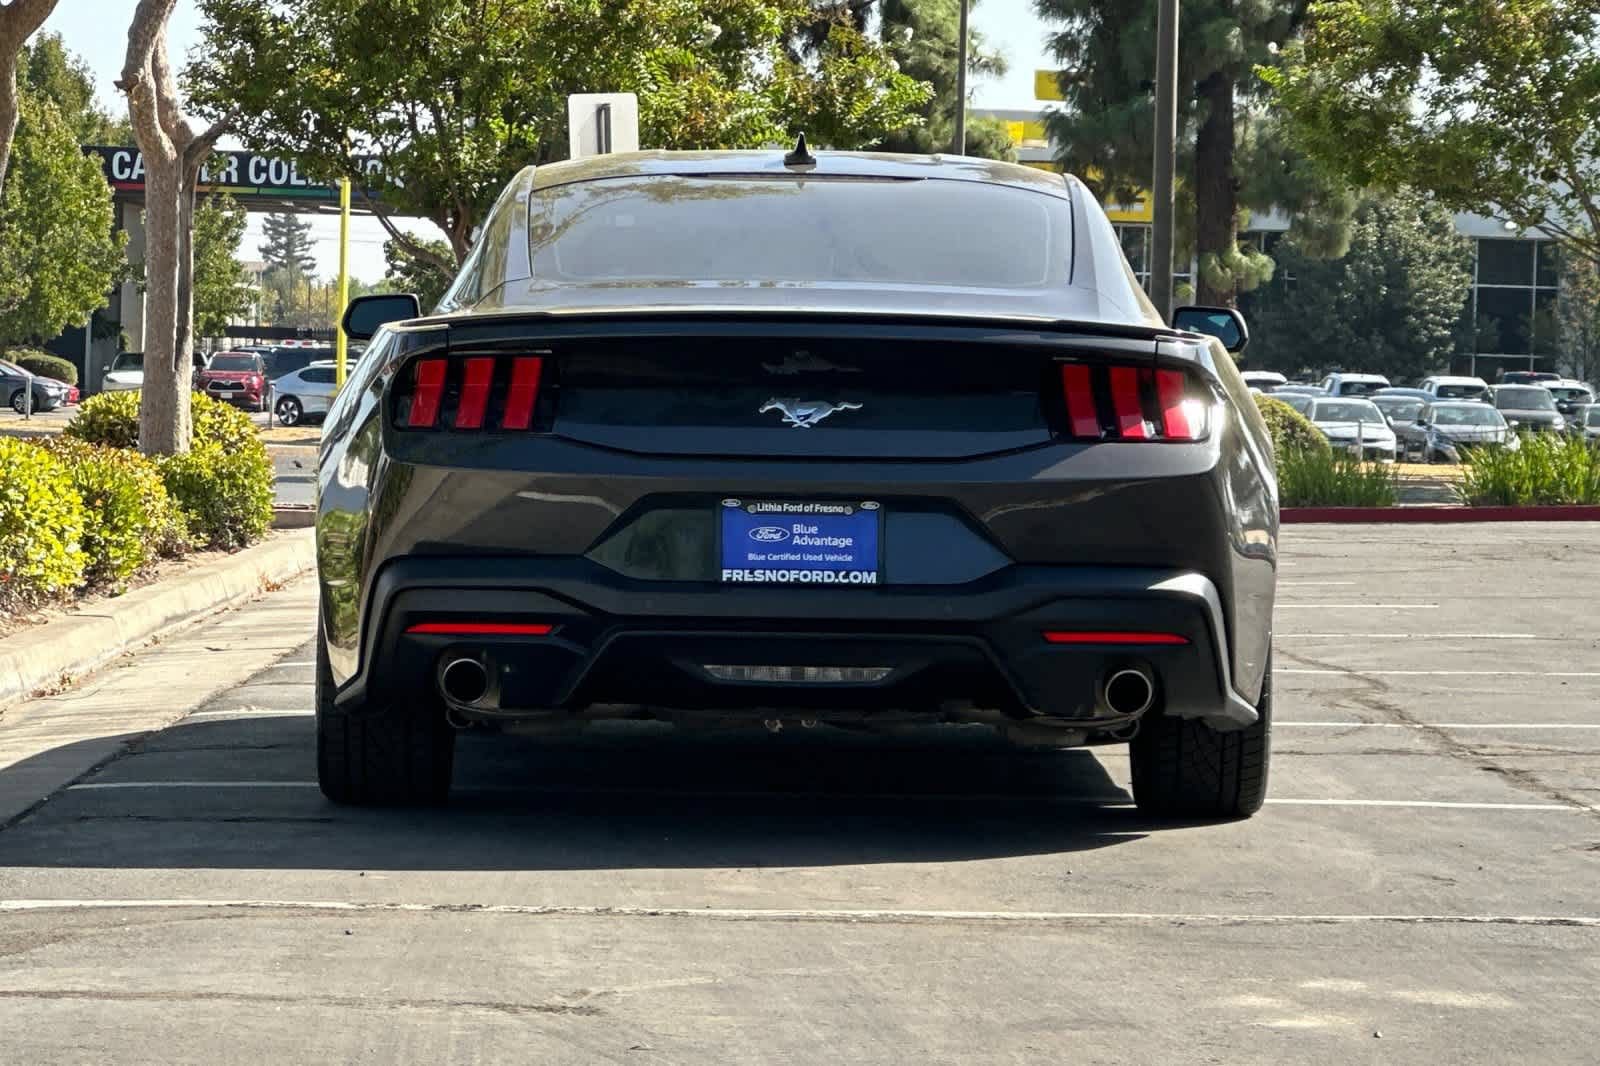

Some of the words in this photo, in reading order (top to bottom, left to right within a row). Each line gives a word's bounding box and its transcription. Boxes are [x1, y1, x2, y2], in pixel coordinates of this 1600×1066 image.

[757, 502, 782, 512] Lithia
[783, 503, 803, 512] Ford
[804, 503, 814, 513] of
[815, 504, 844, 513] Fresno
[754, 527, 784, 540] Ford
[792, 524, 818, 534] Blue
[792, 535, 853, 548] Advantage
[748, 553, 766, 561] Blue
[767, 553, 801, 561] Certified
[803, 553, 823, 561] Used
[824, 553, 853, 562] Vehicle
[721, 569, 877, 584] FRESNOFORD.COM
